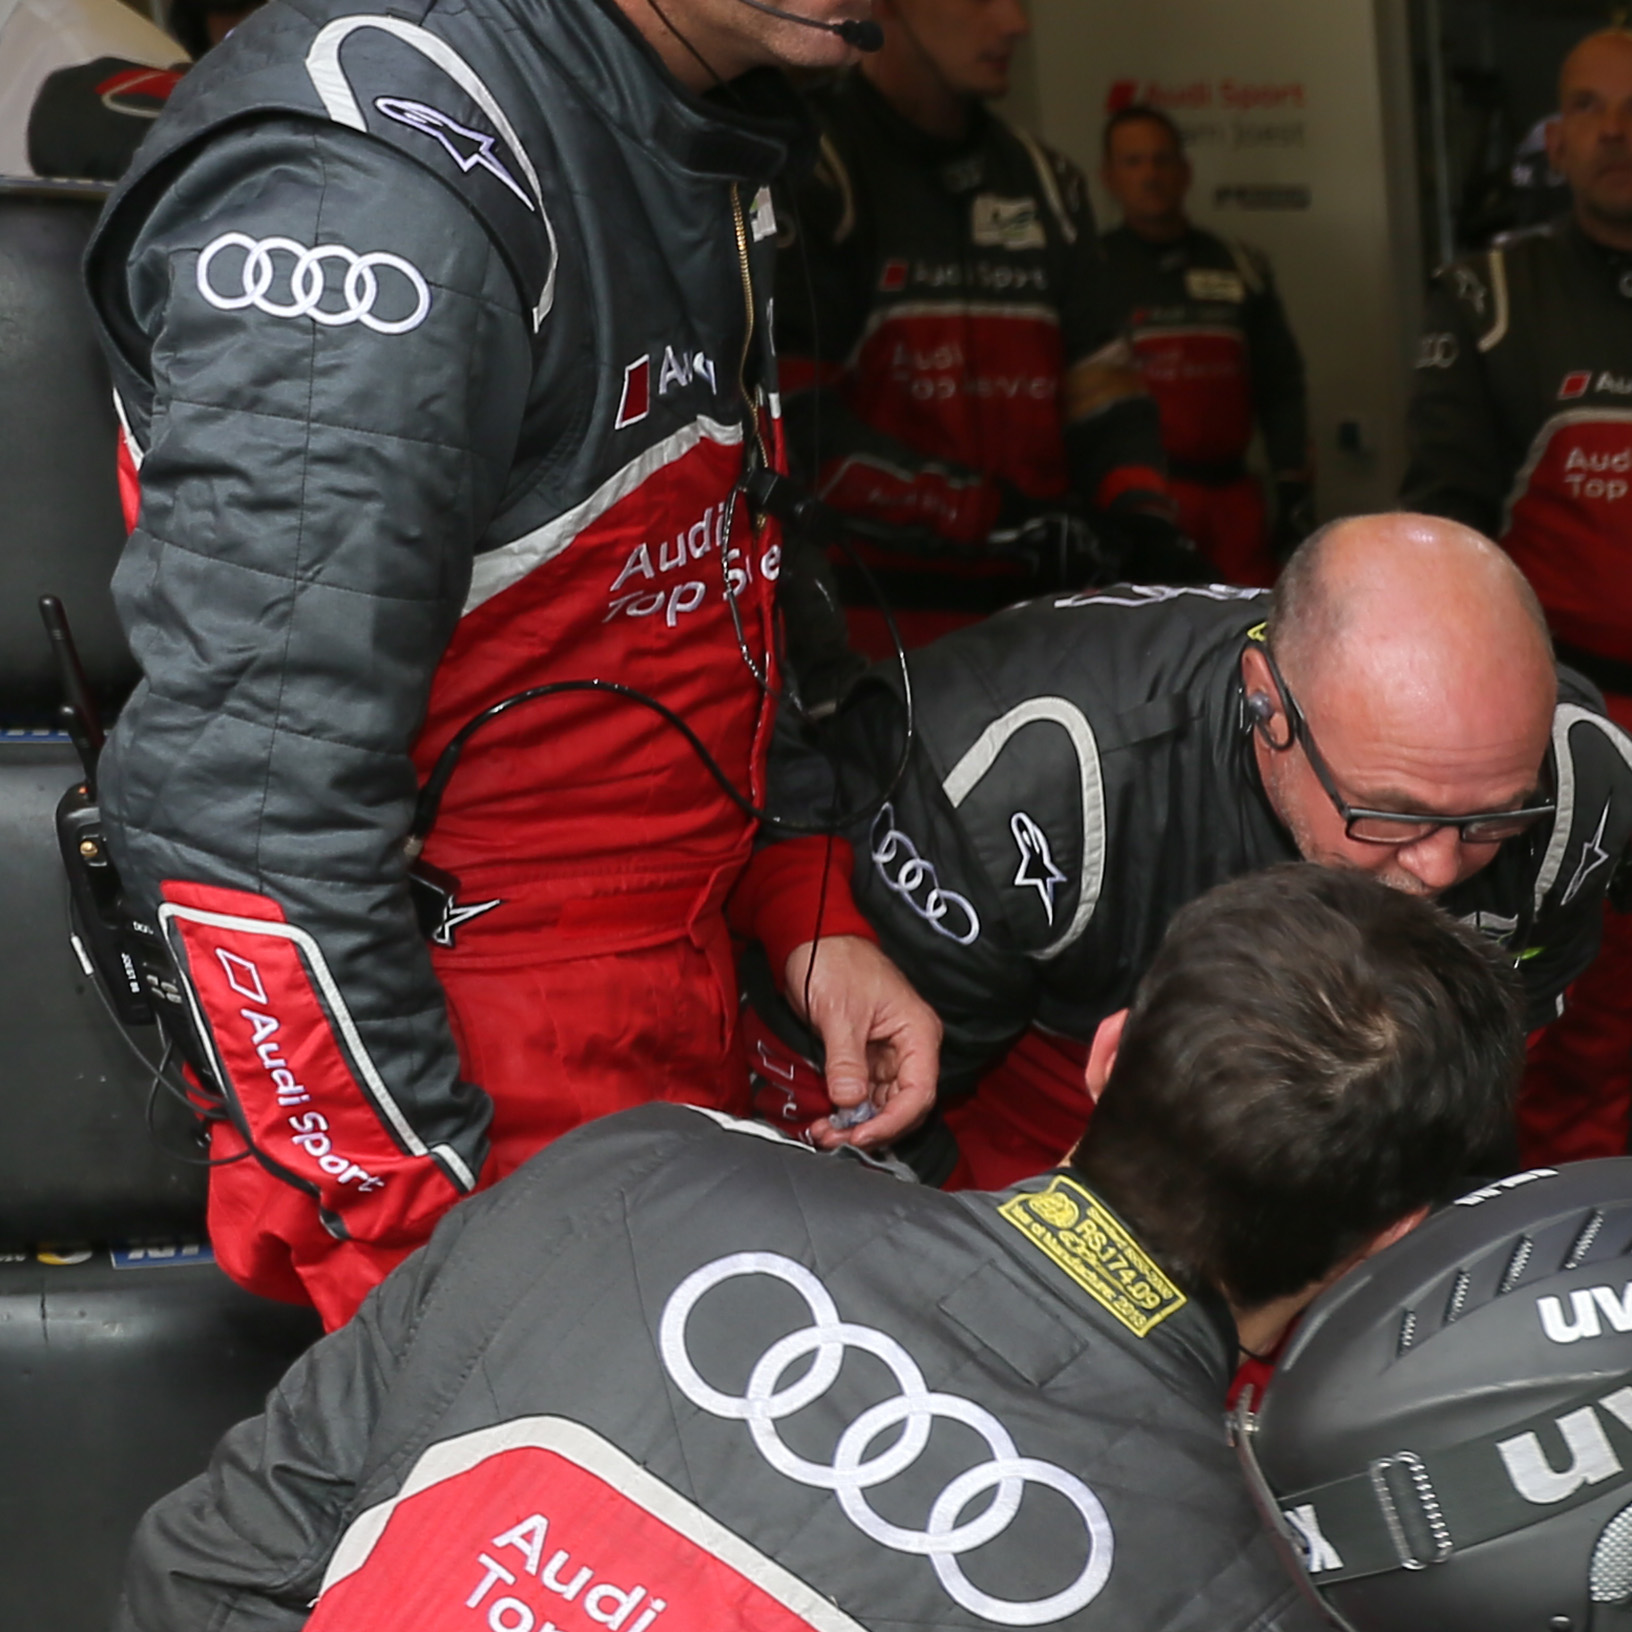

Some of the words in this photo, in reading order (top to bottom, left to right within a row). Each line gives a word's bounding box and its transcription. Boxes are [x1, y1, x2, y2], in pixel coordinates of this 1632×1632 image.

[1564, 472, 1629, 503] Top
[610, 502, 726, 592] Audi
[601, 580, 706, 627] Top
[240, 1008, 311, 1106] Audi
[288, 1111, 385, 1192] Sport
